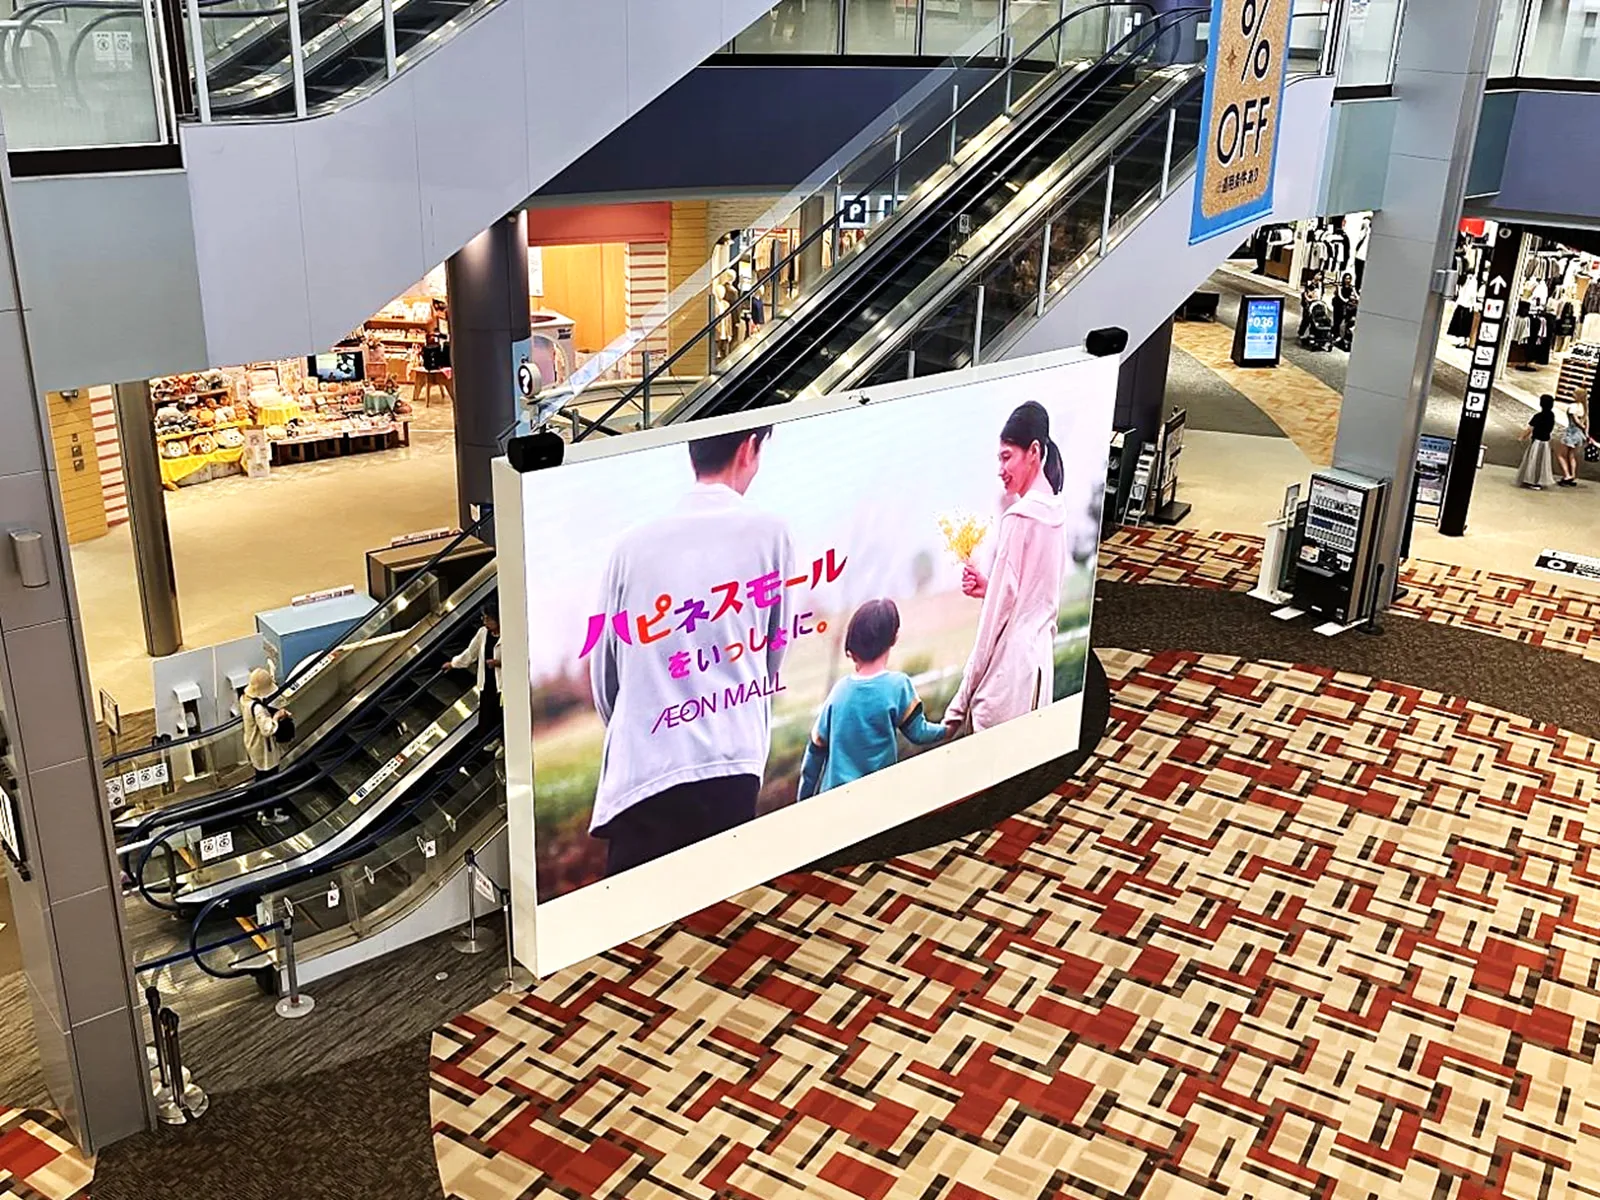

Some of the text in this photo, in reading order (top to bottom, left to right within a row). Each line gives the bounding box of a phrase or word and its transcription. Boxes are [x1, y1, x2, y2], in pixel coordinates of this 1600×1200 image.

[1216, 96, 1271, 166] OFF
[578, 548, 848, 659] ハピネスモール
[668, 612, 827, 679] をいっしょに。
[724, 672, 787, 710] MALL
